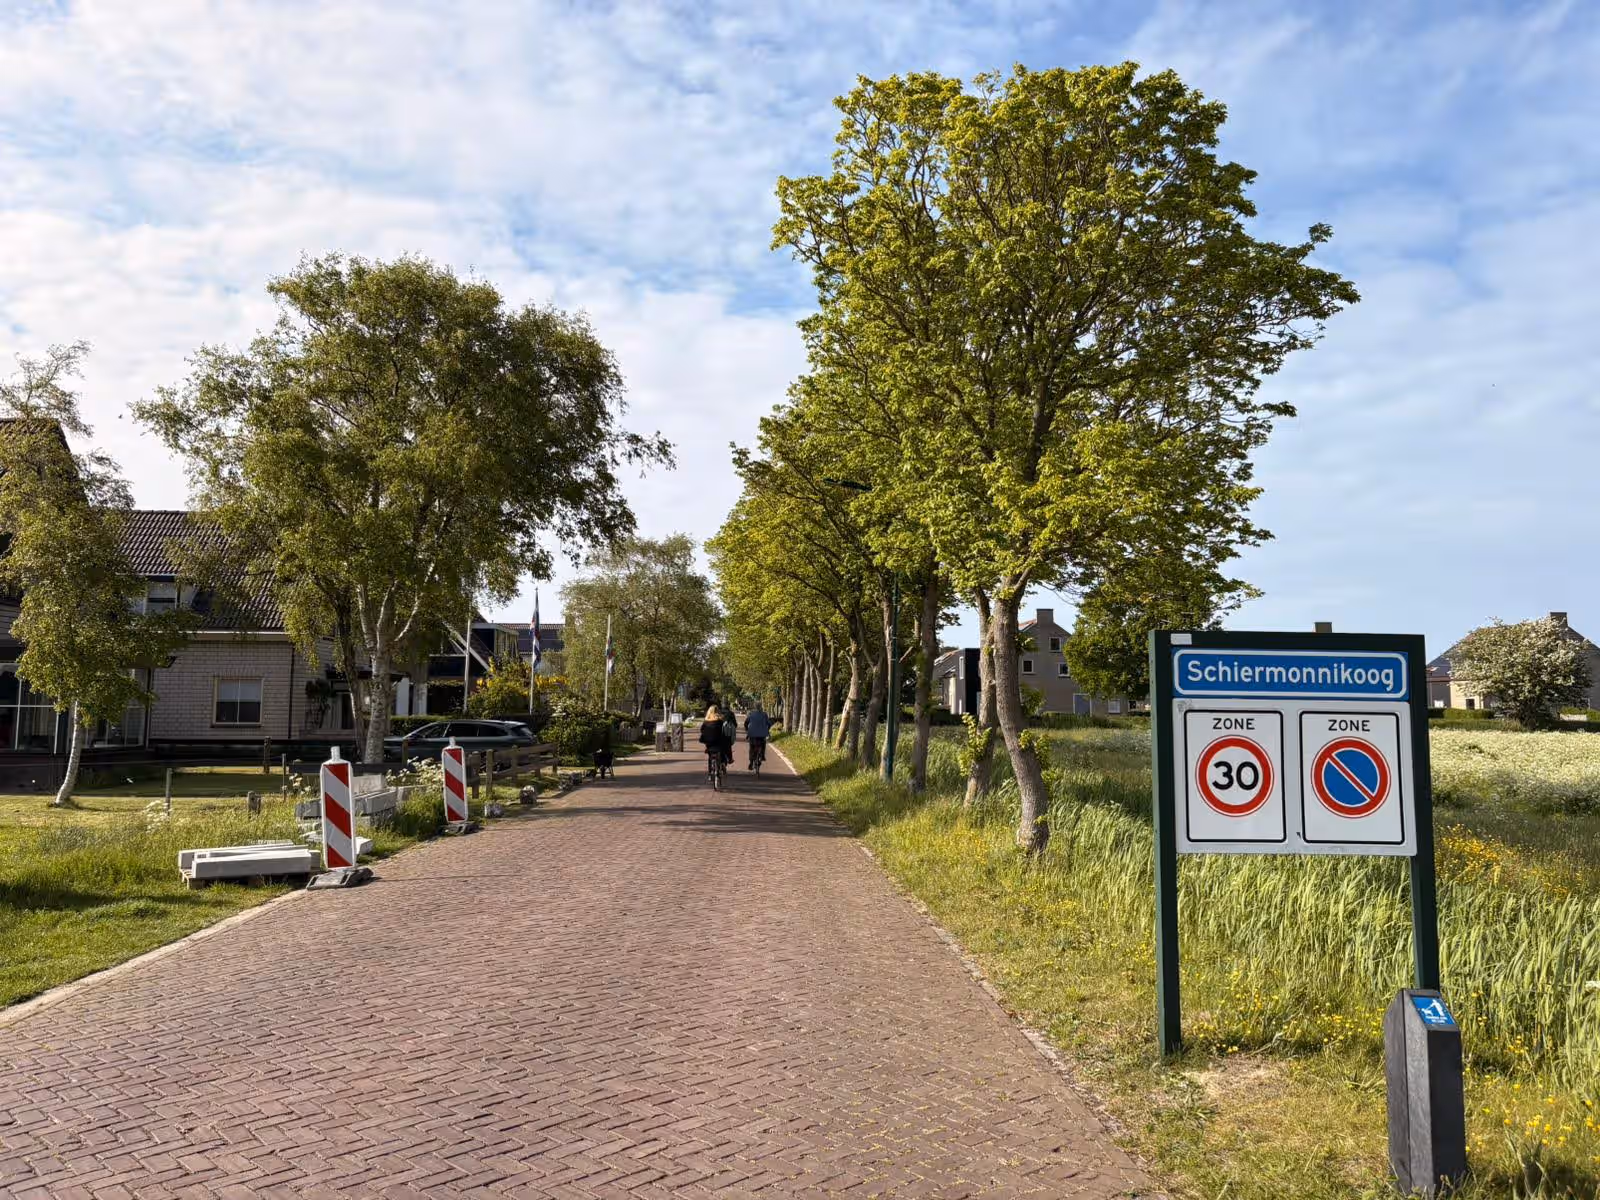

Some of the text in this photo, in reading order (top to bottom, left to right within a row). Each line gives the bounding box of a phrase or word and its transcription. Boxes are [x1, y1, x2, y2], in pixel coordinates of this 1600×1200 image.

[1187, 660, 1394, 692] Schiermonnikoog
[1212, 718, 1255, 730] ZONE
[1328, 719, 1370, 732] ZONE
[1212, 761, 1259, 790] 30
